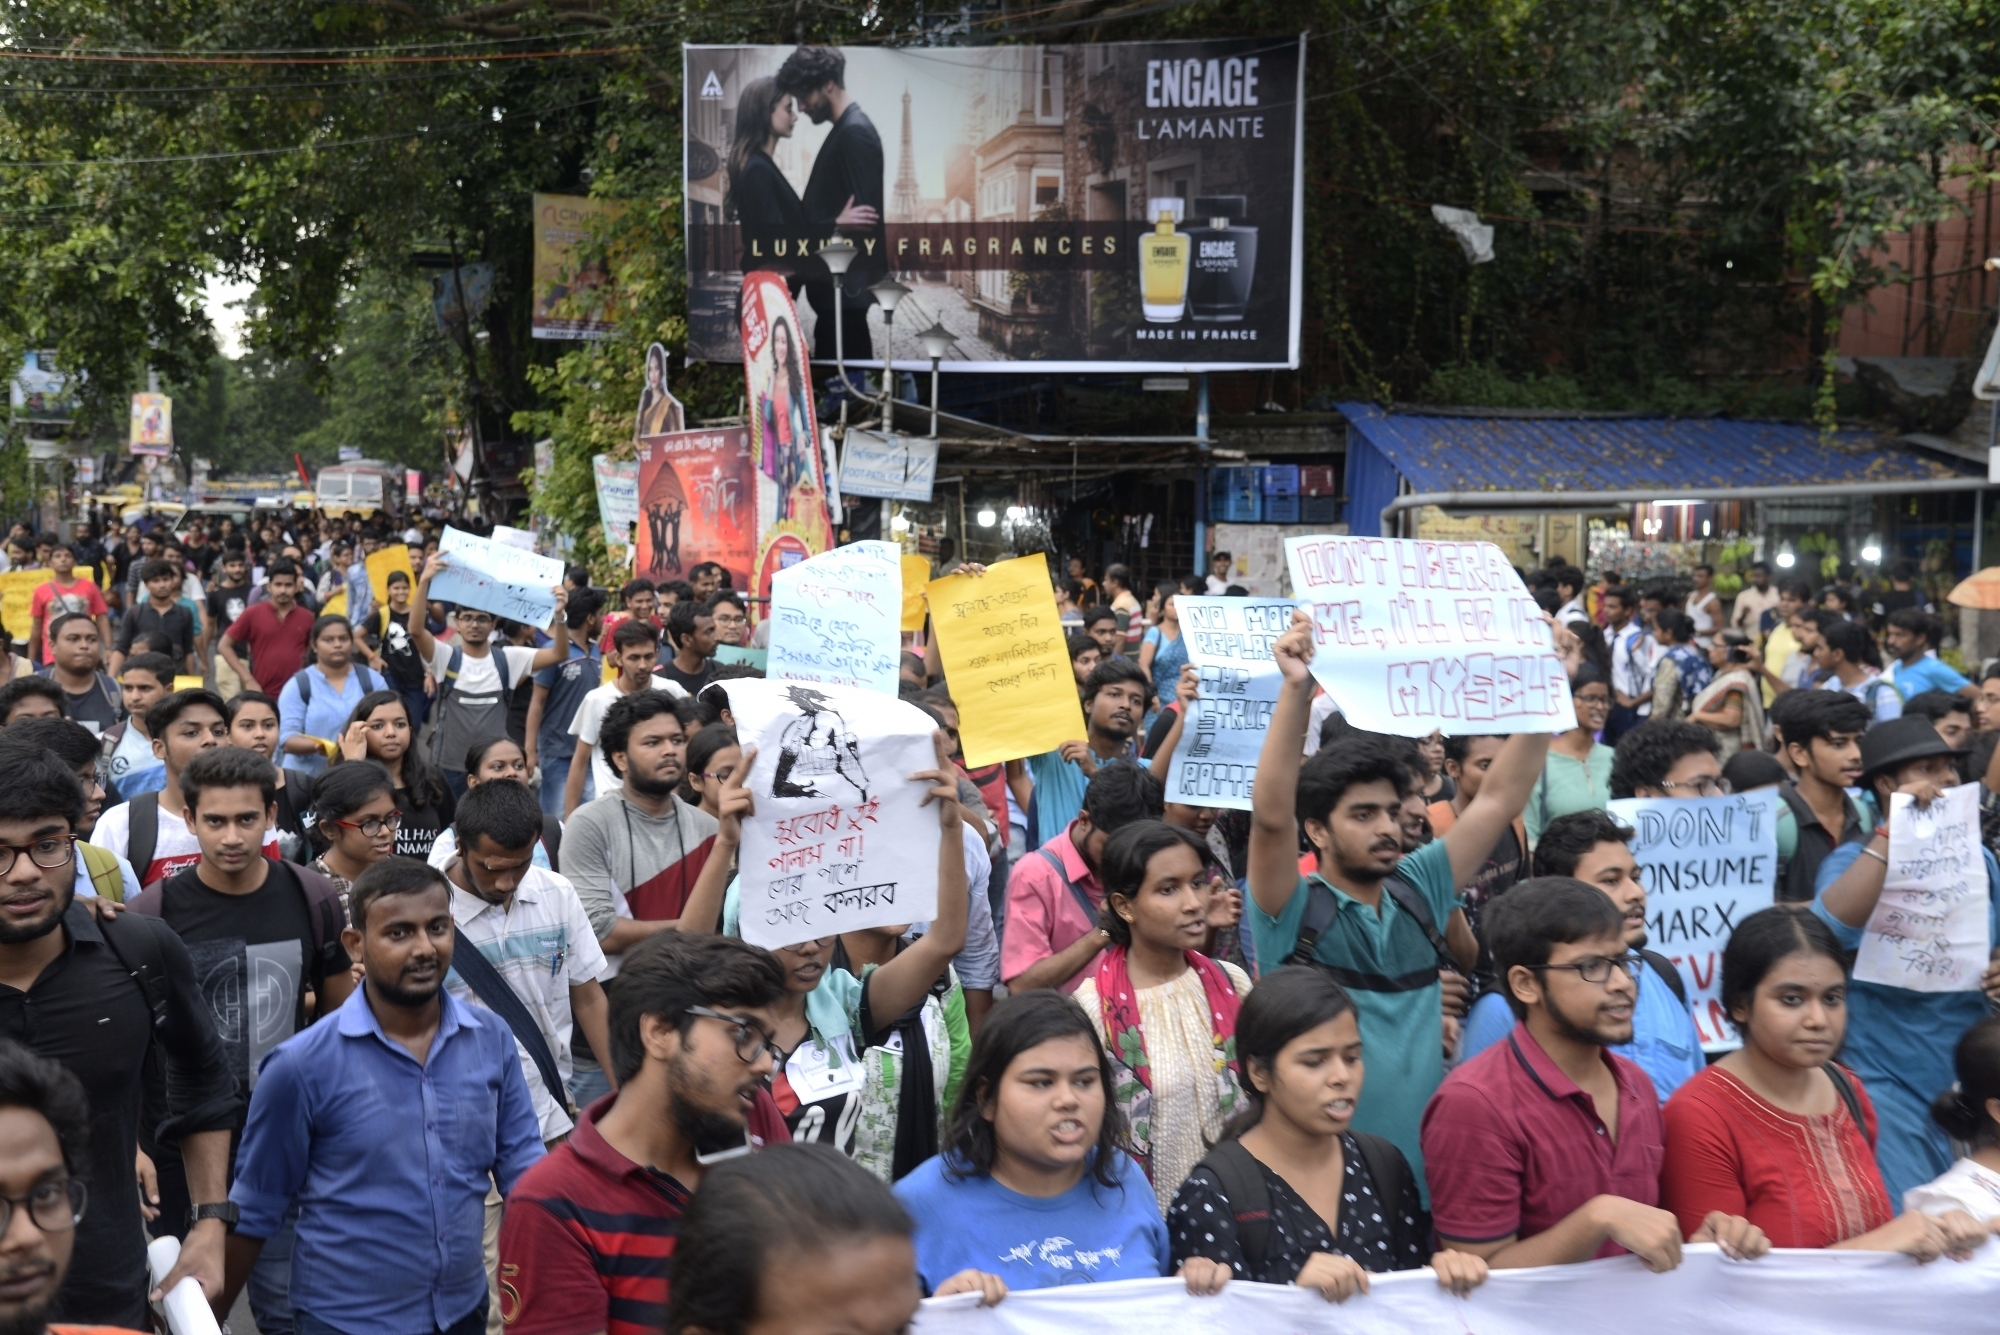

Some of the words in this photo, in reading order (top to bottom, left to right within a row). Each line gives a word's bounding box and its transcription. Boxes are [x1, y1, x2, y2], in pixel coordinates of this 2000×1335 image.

[1146, 58, 1259, 108] ENGAGE
[1138, 117, 1264, 140] L'AMANTE
[898, 236, 1116, 255] FRAGRANCES
[1199, 241, 1236, 258] ENGAGE
[1136, 329, 1174, 340] MADE
[1181, 329, 1196, 340] IN
[1202, 329, 1258, 340] FRANCE
[1297, 538, 1388, 588] DON'T
[1187, 606, 1227, 630] NO
[1244, 605, 1297, 631] MOR
[1194, 632, 1279, 661] REPLAS
[1201, 665, 1252, 694] THE
[1387, 652, 1564, 721] MYSELF
[1179, 761, 1258, 799] ROTTE
[412, 828, 438, 841] HAS
[773, 803, 843, 846] সুবোধ
[847, 795, 881, 832] তুই
[1636, 795, 1768, 851] DON'T
[768, 873, 807, 900] তোর
[817, 858, 865, 886] পাশে
[1645, 854, 1769, 897] ONSUME
[765, 897, 813, 926] আজ
[823, 882, 899, 914] কলরব
[1644, 899, 1737, 944] MARX
